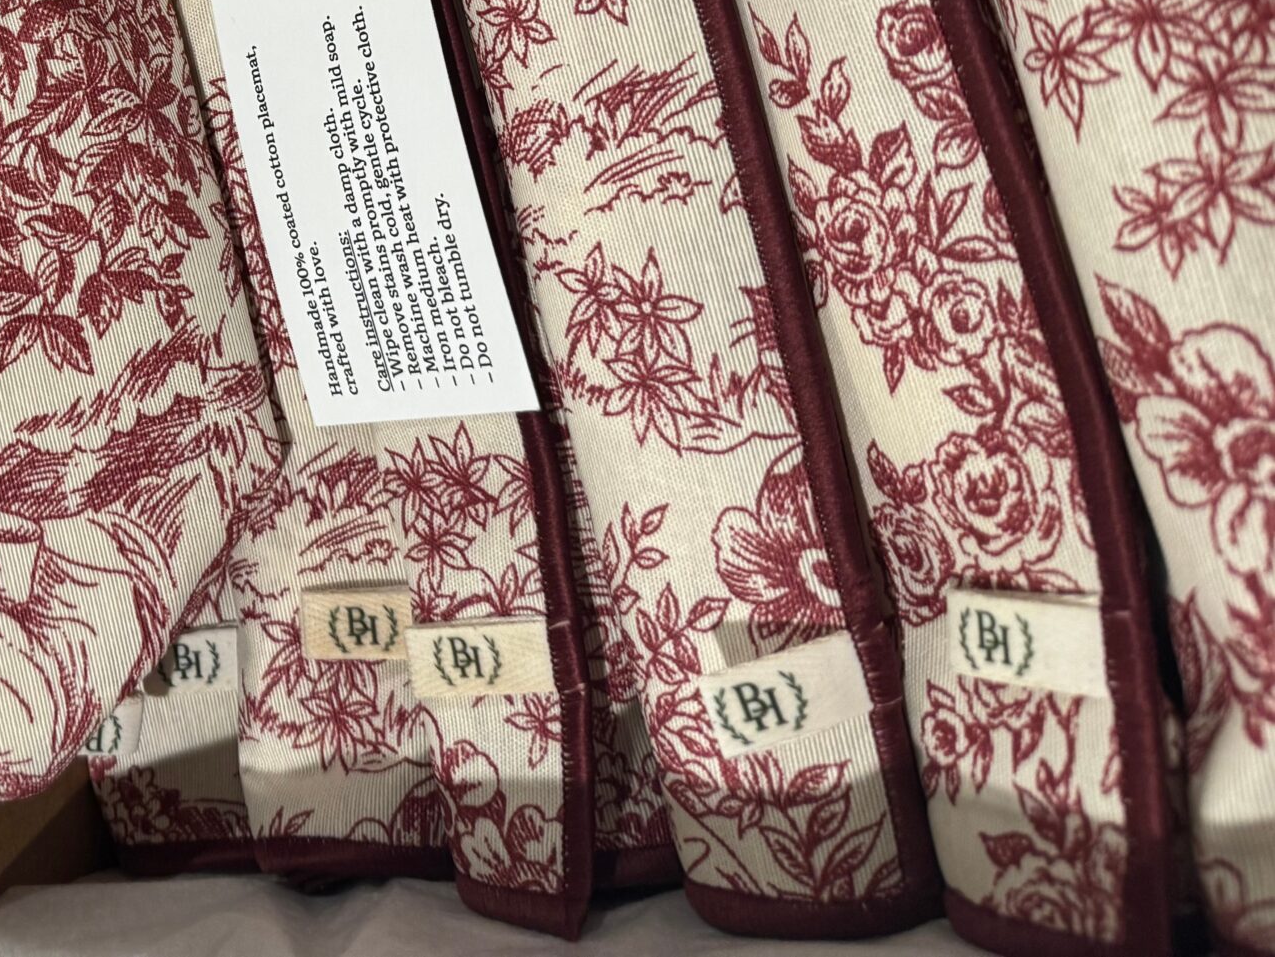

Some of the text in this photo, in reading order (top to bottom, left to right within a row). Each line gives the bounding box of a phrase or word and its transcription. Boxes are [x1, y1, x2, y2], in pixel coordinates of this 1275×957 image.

[321, 14, 339, 62] soap.
[351, 4, 372, 58] cloth.
[327, 63, 349, 108] mild
[350, 77, 373, 130] cycle.
[364, 60, 399, 155] protective
[322, 107, 344, 160] cloth.
[338, 109, 359, 154] with
[362, 132, 390, 190] gentle
[385, 155, 407, 202] with
[336, 162, 358, 214] damp
[351, 155, 387, 242] promptly
[433, 192, 452, 230] dry.
[245, 44, 343, 396] Handmade 100% coated cotton placemat,
[351, 215, 362, 228] a
[376, 192, 399, 238] cold,
[397, 202, 420, 246] heat
[352, 230, 374, 274] with
[375, 243, 399, 299] stains
[389, 239, 414, 290] wash
[426, 235, 455, 305] bleach.
[443, 232, 473, 302] tumble
[338, 229, 393, 392] Care instructions:
[367, 275, 389, 325] clean
[411, 247, 444, 327] medium
[308, 240, 359, 395] crafted with love.
[391, 301, 422, 375] Remove
[406, 292, 439, 373] Machine
[444, 306, 466, 340] not
[462, 303, 484, 338] not
[381, 327, 404, 378] Wipe
[436, 329, 457, 372] Iron
[458, 342, 475, 370] Do
[476, 340, 493, 368] Do
